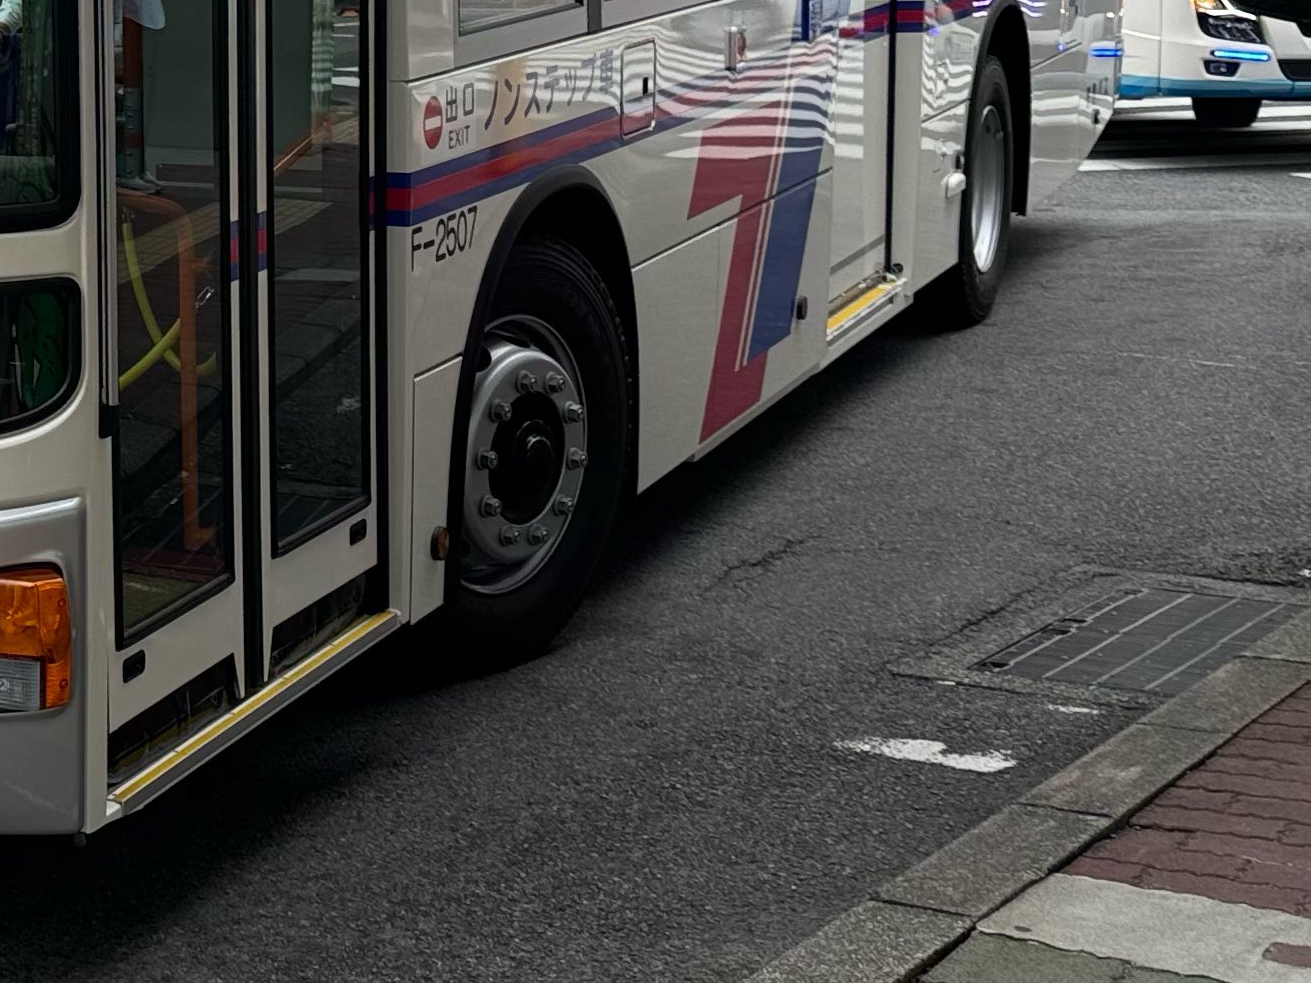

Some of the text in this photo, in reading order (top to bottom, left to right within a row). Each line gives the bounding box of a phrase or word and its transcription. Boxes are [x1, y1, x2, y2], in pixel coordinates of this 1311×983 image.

[445, 82, 475, 124] 出口
[484, 48, 614, 131] ノンステップ車
[448, 125, 471, 149] EXIT
[411, 205, 478, 272] F-2507
